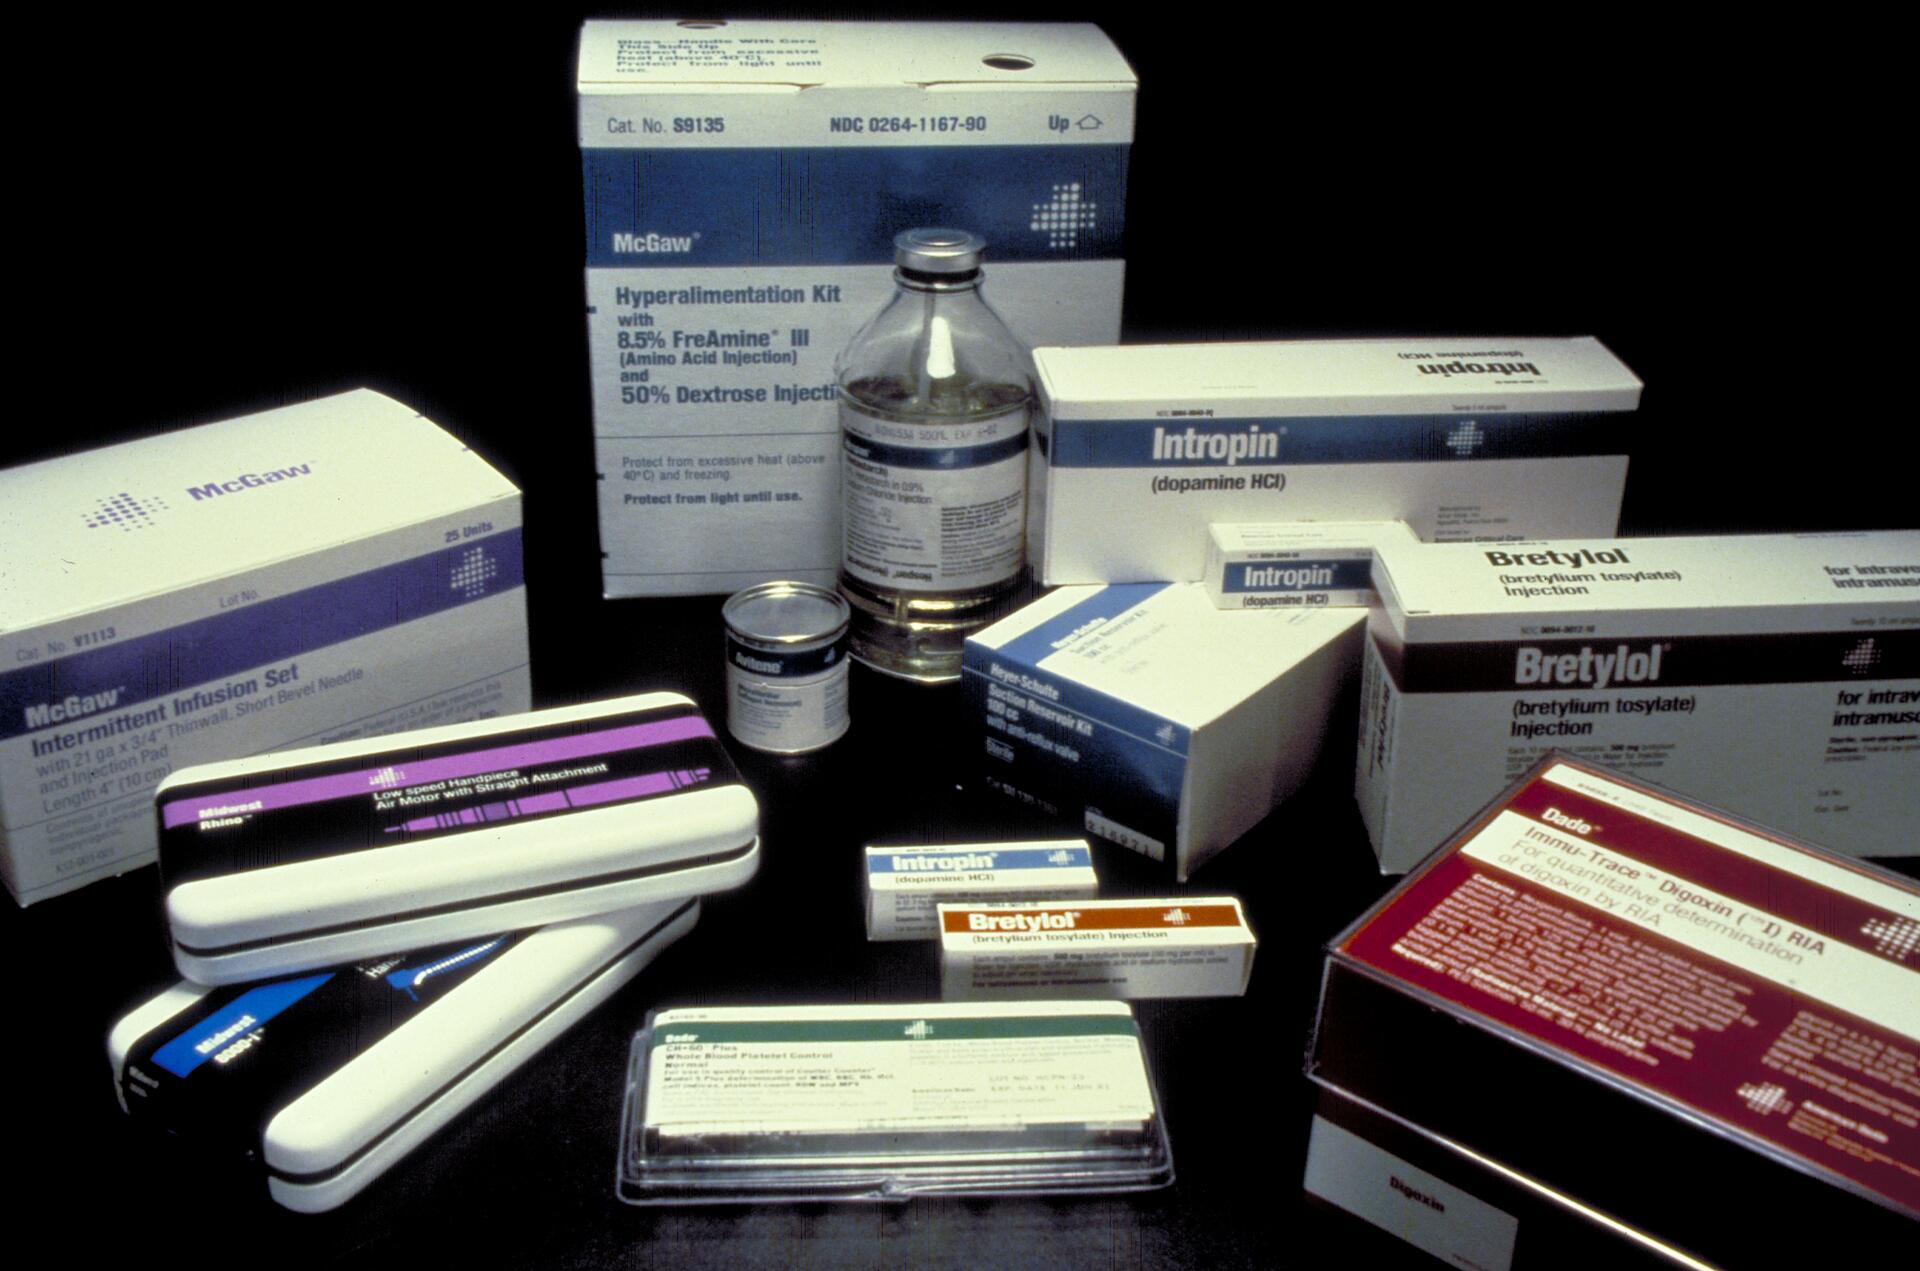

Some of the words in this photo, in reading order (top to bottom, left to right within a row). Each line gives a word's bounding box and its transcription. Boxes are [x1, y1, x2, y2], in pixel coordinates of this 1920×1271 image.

[608, 118, 636, 133] Cat.
[643, 118, 667, 133] No.
[673, 117, 724, 133] S9135
[830, 116, 864, 132] NDC
[869, 115, 987, 132] 0264-1167-90
[1049, 115, 1069, 132] Up
[613, 233, 691, 252] McGaw
[616, 286, 804, 308] Hyperalimentation
[813, 285, 841, 303] Kit
[618, 313, 654, 327] with
[618, 331, 665, 349] 8.5%
[673, 330, 770, 348] FreAmine
[791, 329, 809, 346] III
[620, 352, 676, 368] (Amino
[682, 351, 717, 365] Acid
[723, 350, 797, 367] Injection)
[621, 370, 649, 383] and
[1417, 361, 1542, 378] Intropin
[621, 386, 670, 404] 50%
[676, 386, 767, 403] Dextrose
[1153, 425, 1278, 466] Intropin
[622, 457, 662, 468] Protect
[667, 456, 693, 467] from
[698, 456, 753, 466] excessive
[758, 455, 782, 464] heat
[787, 454, 825, 466] (above
[185, 463, 312, 501] McGaw
[660, 470, 680, 481] and
[1152, 474, 1245, 494] (dopamine
[1251, 473, 1286, 492] HCl)
[624, 494, 671, 505] Protect
[676, 494, 706, 504] from
[711, 493, 739, 505] light
[743, 492, 772, 502] until
[776, 491, 803, 502] use.
[444, 530, 460, 543] 25
[463, 521, 493, 538] Units
[1484, 549, 1630, 569] Bretylol
[1244, 565, 1332, 588] Intropin
[1499, 573, 1595, 584] (bretylium
[1601, 571, 1682, 582] tosylate)
[1823, 565, 1851, 576] for
[219, 593, 240, 609] Lot
[1504, 585, 1589, 597] Injection
[1243, 595, 1302, 608] (dopamine
[1515, 644, 1664, 690] Bretylol
[990, 663, 1059, 700] Heyer-Schulte
[1513, 699, 1609, 719] (bretylium
[1616, 696, 1695, 715] tosylate)
[1837, 691, 1863, 705] for
[24, 688, 119, 729] McGaw
[31, 705, 166, 757] Intermittent
[173, 678, 258, 717] Infusion
[264, 663, 299, 688] Set
[988, 683, 1026, 711] Suction
[1076, 720, 1093, 737] Kit
[36, 758, 71, 777] with
[74, 750, 91, 767] 21
[96, 746, 115, 764] ga
[118, 743, 127, 753] x
[236, 694, 275, 718] Short
[278, 681, 316, 702] Bevel
[318, 668, 363, 691] Needle
[1511, 721, 1593, 739] Injection
[40, 776, 68, 794] and
[72, 757, 138, 786] Injection
[141, 745, 169, 764] Pad
[373, 790, 402, 801] Low
[405, 782, 446, 798] speed
[449, 770, 518, 788] Handpiece
[376, 800, 395, 811] Air
[399, 793, 440, 806] Motor
[444, 787, 472, 798] with
[476, 777, 529, 794] Straight
[532, 762, 608, 783] Attachment
[43, 787, 97, 815] Length
[198, 800, 262, 819] Midwest
[200, 816, 243, 830] Rhino
[1541, 807, 1592, 835] Dade
[892, 853, 993, 871] Intropin
[896, 873, 964, 884] (dopamine
[1497, 851, 1517, 867] of
[1519, 860, 1592, 897] digoxin
[1595, 891, 1622, 911] by
[1625, 903, 1662, 927] RIA
[1524, 825, 1641, 880] Immu-Trace
[1659, 878, 1733, 919] Digoxin
[1786, 930, 1826, 955] RIA
[1511, 840, 1544, 860] For
[1547, 851, 1659, 911] quantitative
[1663, 900, 1805, 965] determination
[968, 911, 1075, 932] Bretylol
[973, 934, 1042, 944] (bretylium
[1046, 932, 1105, 942] tosylate)
[1108, 929, 1168, 940] Injection
[1389, 1175, 1445, 1213] Digoxin
